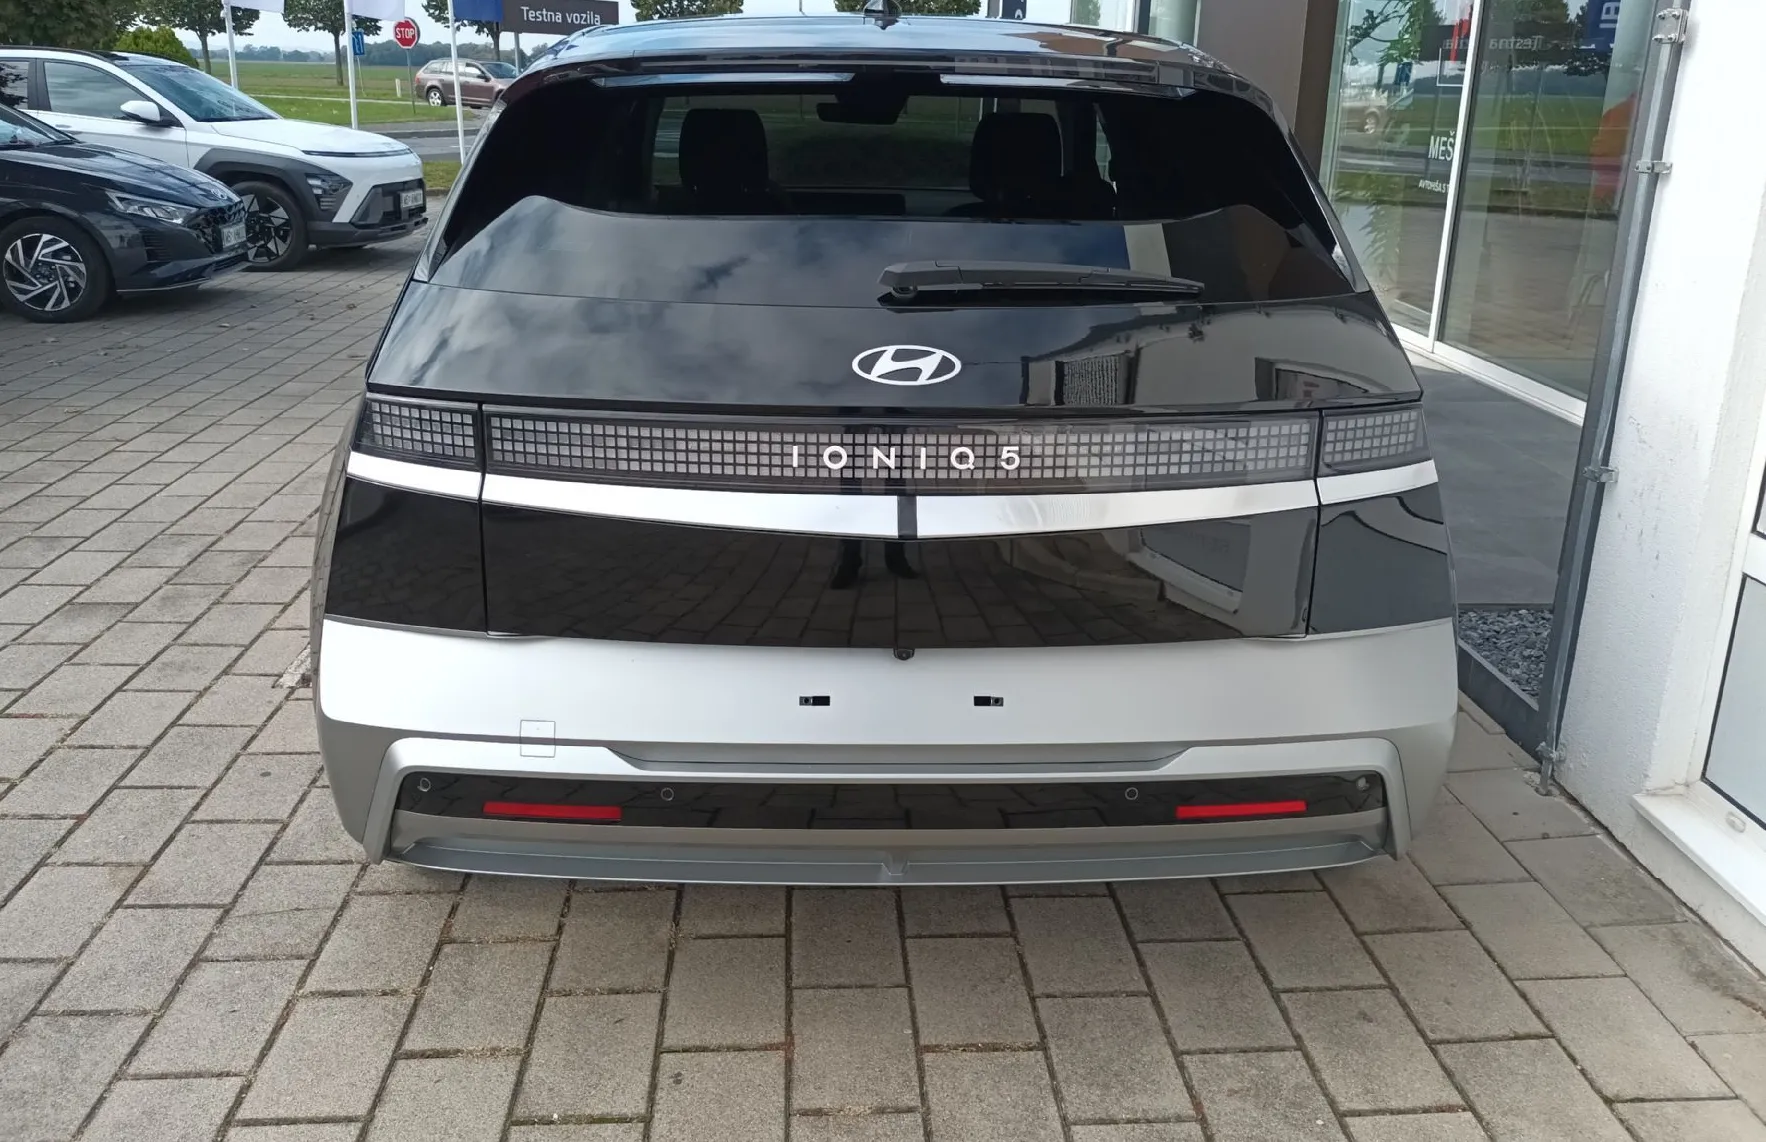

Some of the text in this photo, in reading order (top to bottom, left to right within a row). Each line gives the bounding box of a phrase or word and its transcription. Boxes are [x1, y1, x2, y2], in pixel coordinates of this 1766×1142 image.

[520, 6, 601, 26] Testna vozila
[396, 28, 415, 39] STOP
[792, 445, 1020, 470] IONIQ 5
